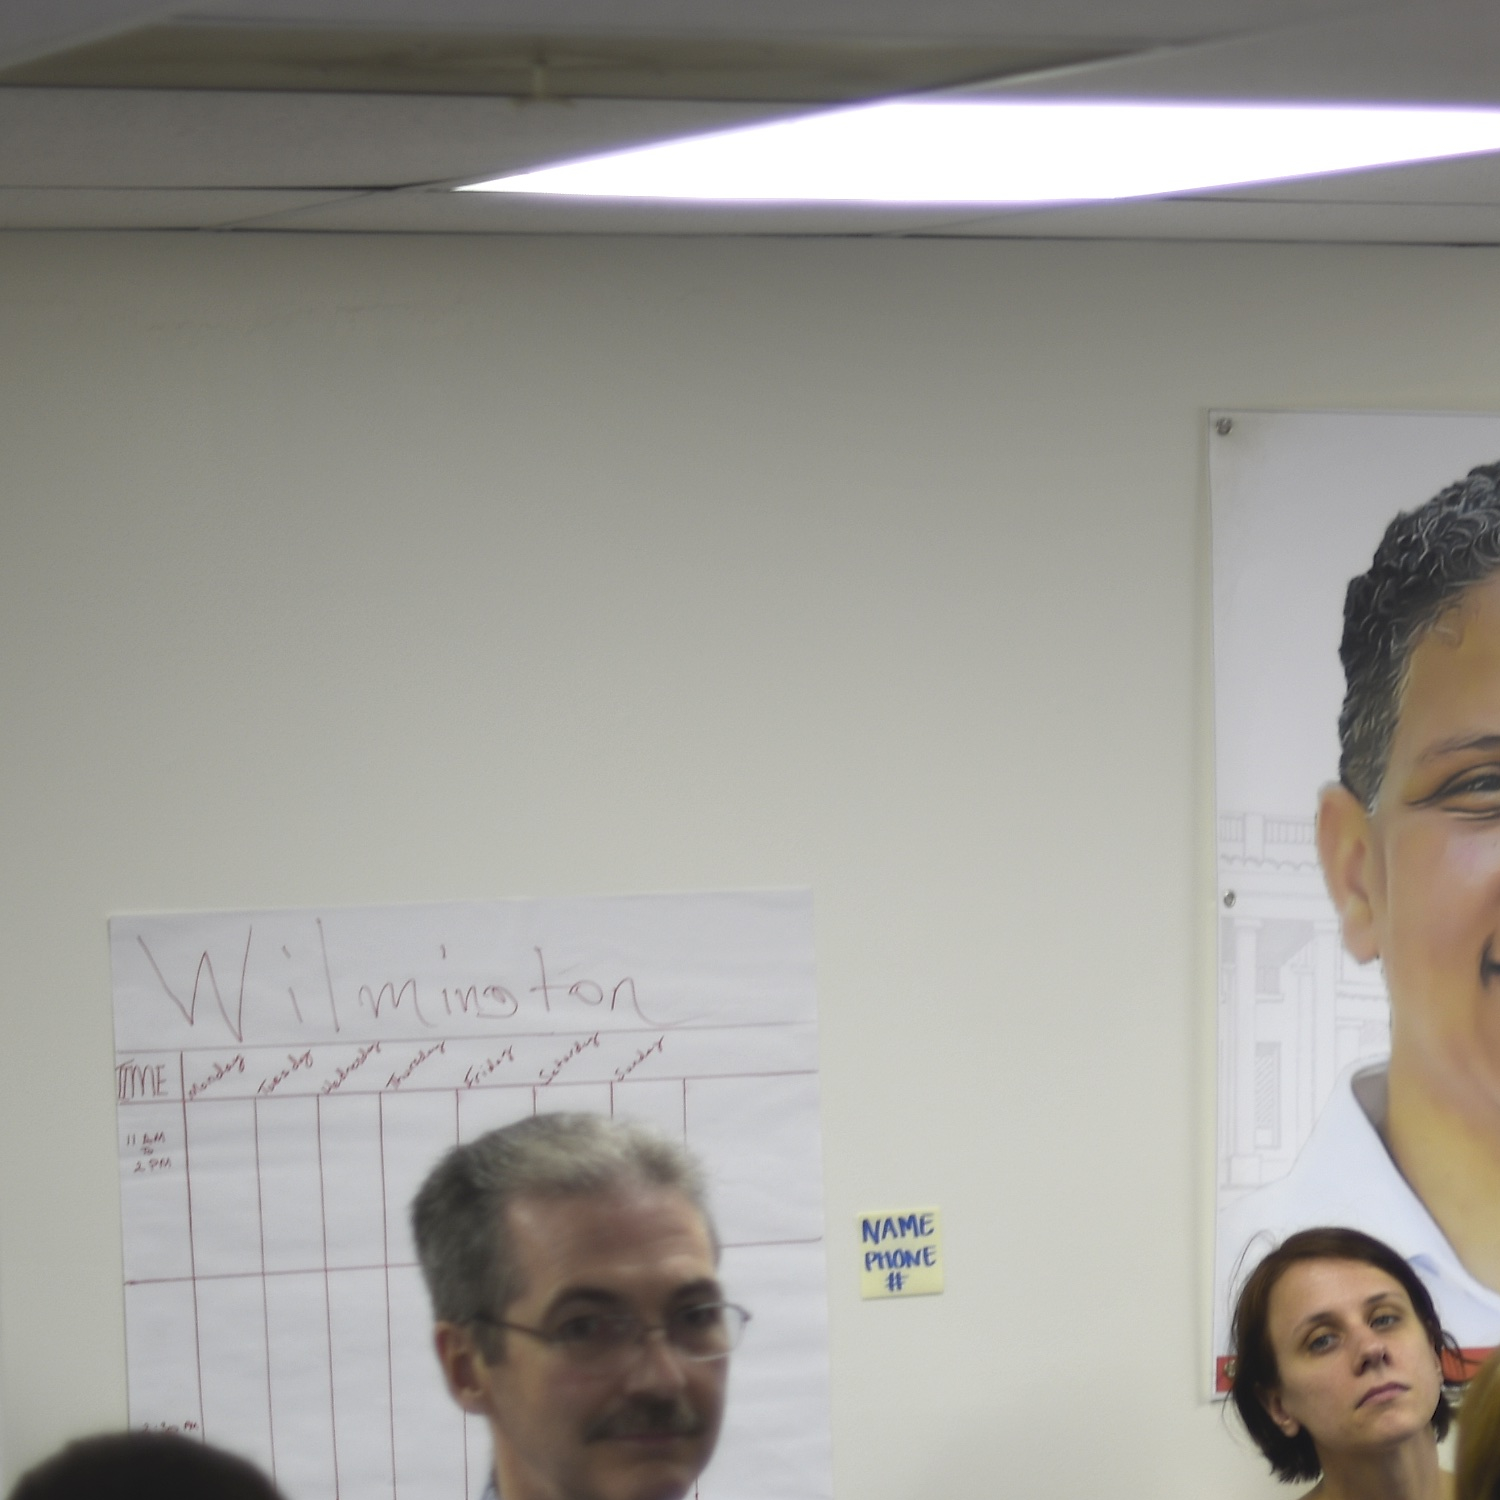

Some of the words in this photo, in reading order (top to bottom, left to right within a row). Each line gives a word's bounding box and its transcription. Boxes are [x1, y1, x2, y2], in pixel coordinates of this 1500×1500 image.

[136, 918, 714, 1043] Wilmington
[114, 1057, 169, 1100] TIME
[862, 1212, 934, 1245] NAME
[864, 1245, 937, 1273] PHONE
